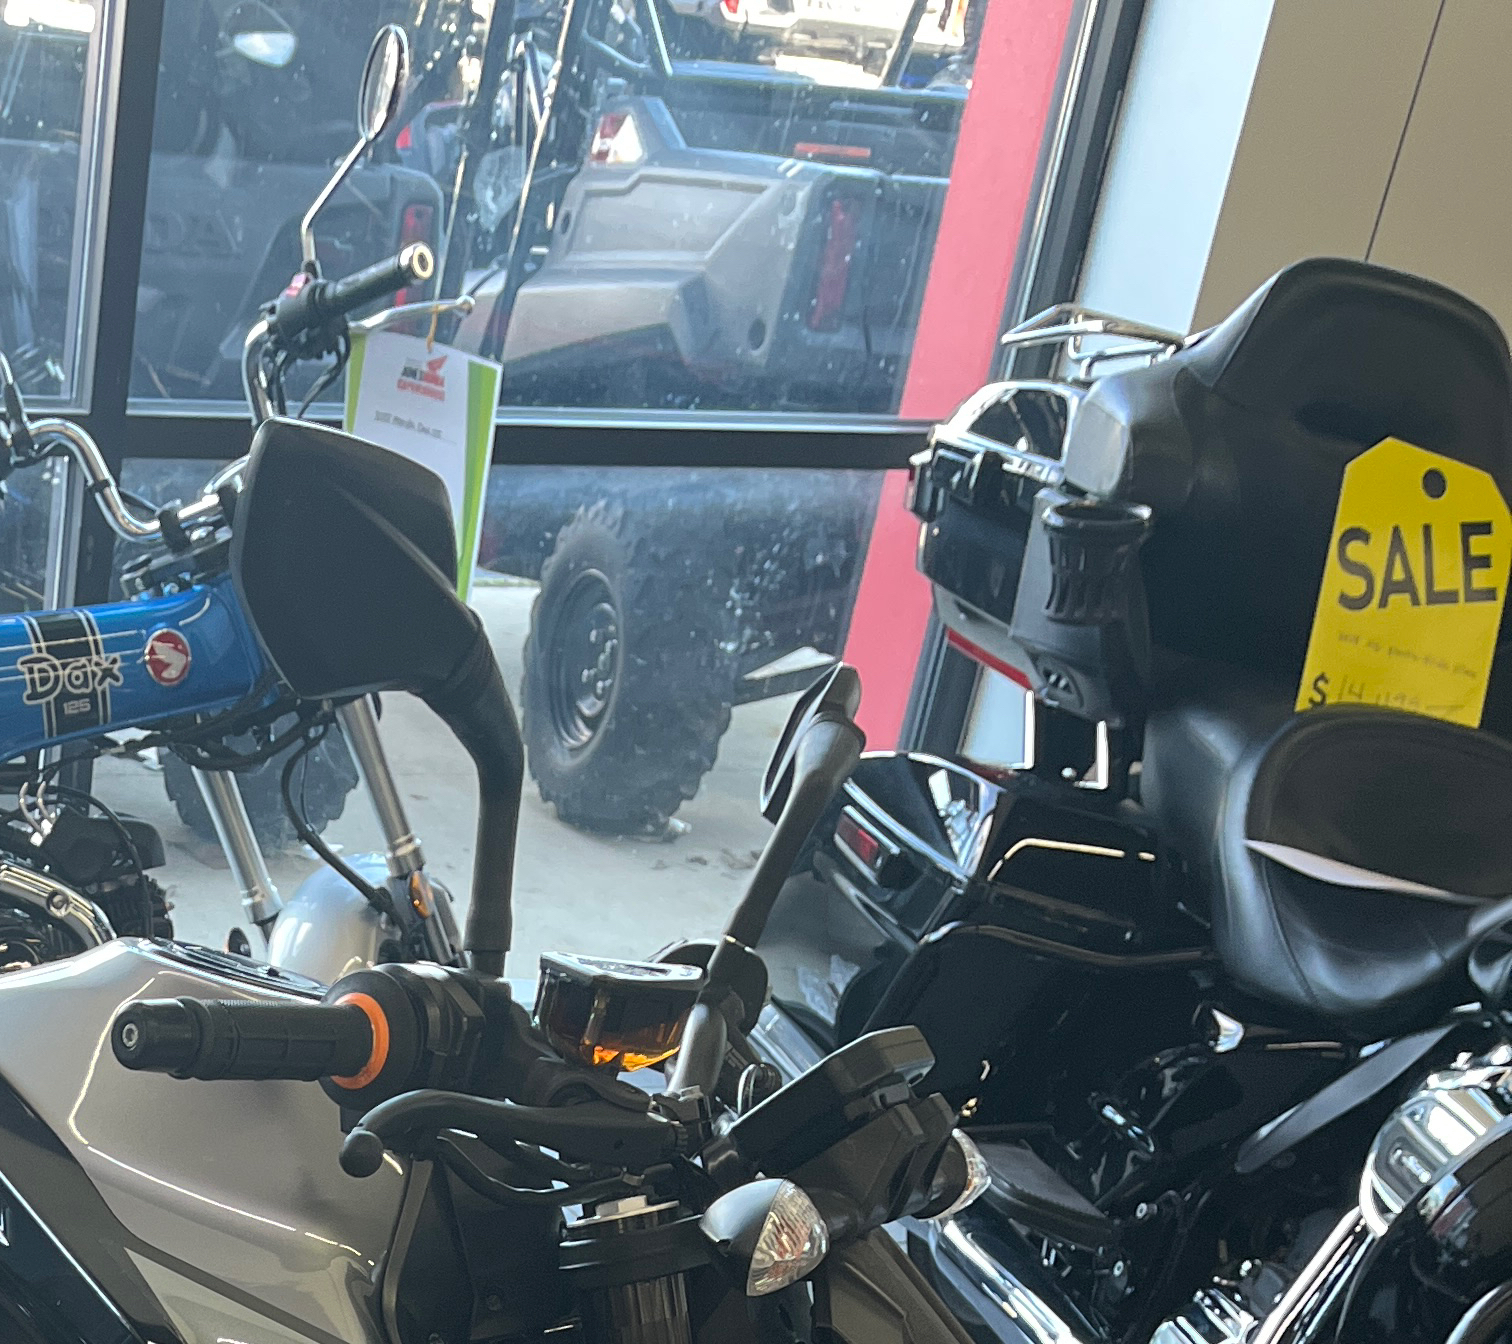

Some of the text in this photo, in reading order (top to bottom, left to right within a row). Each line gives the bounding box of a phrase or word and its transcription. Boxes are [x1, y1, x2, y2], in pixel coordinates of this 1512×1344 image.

[1337, 520, 1498, 610] SALE
[17, 653, 124, 704] Dax
[63, 698, 91, 714] 125
